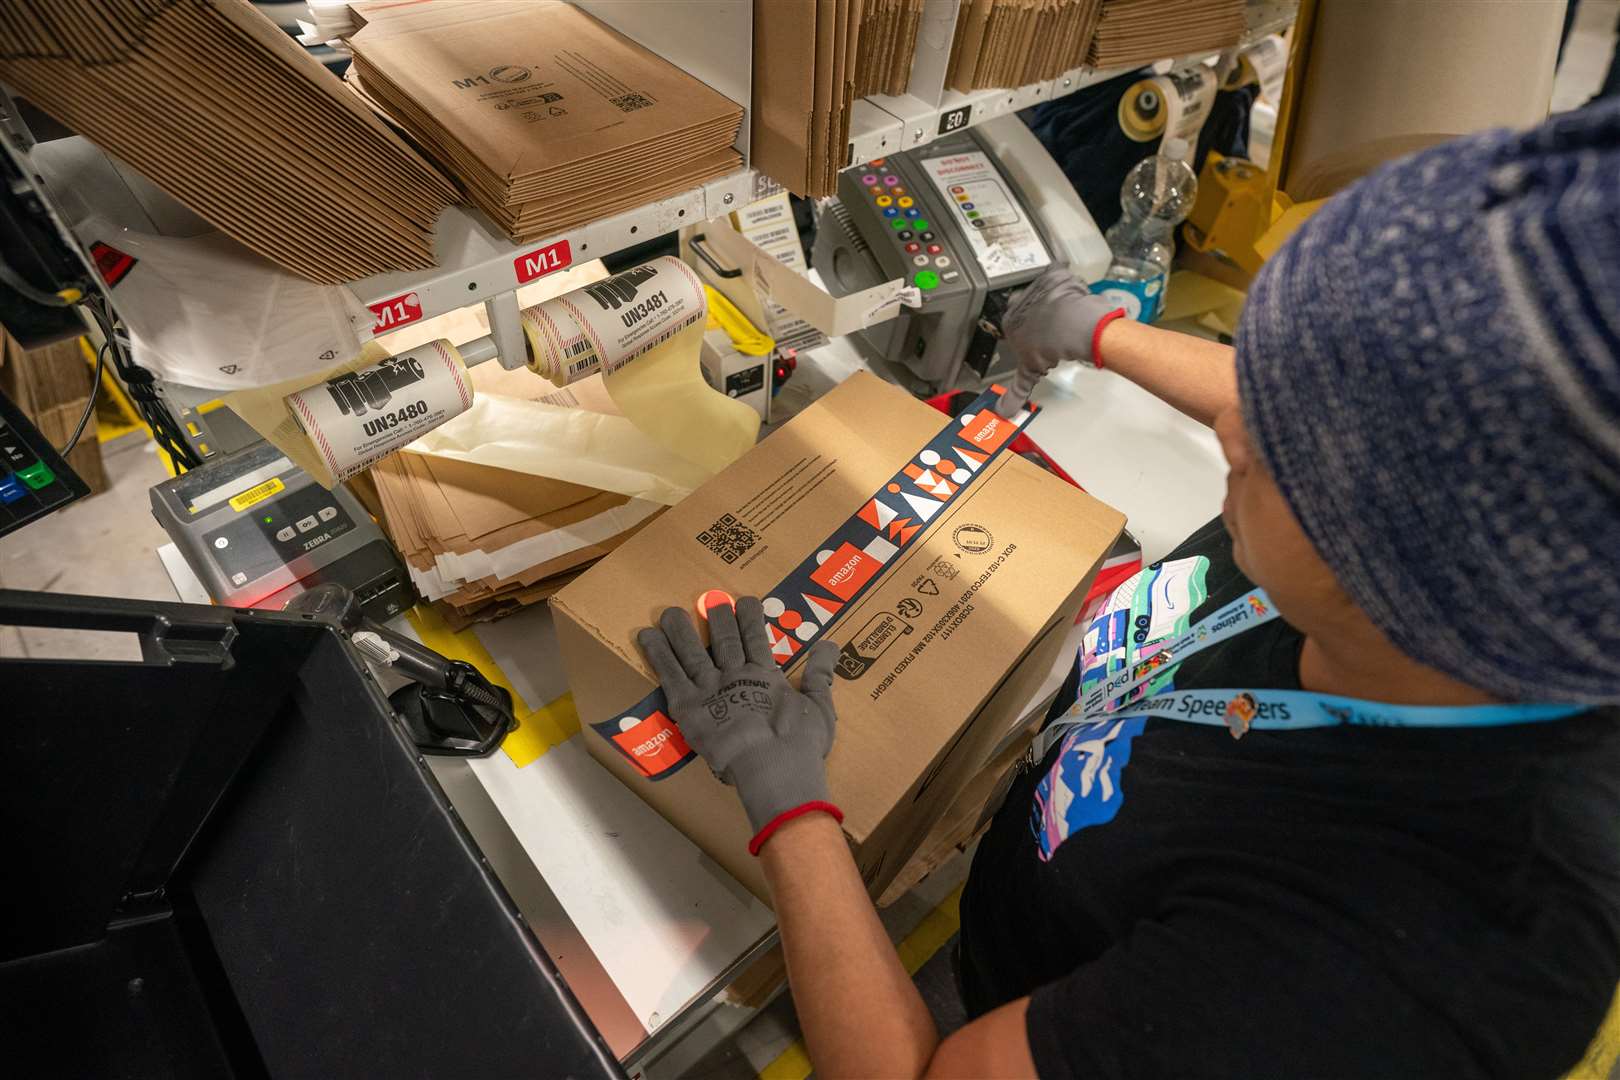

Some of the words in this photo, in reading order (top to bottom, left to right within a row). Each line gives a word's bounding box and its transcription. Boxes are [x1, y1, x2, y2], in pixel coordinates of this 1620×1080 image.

[451, 74, 491, 90] M1
[525, 248, 562, 277] M1
[374, 300, 410, 329] M1
[621, 290, 668, 328] UN3481
[363, 400, 428, 437] UN3480
[974, 418, 1000, 442] amazon
[303, 532, 332, 551] ZEBRA
[1002, 543, 1017, 559] BOX
[828, 554, 863, 587] amazon
[987, 555, 1006, 573] C-102
[970, 570, 992, 592] FEFCO
[940, 604, 975, 641] DCBOX1117
[1211, 610, 1248, 634] Latinos
[911, 641, 927, 655] MM
[894, 652, 916, 674] FIXED
[870, 672, 897, 701] HEIGHT
[631, 727, 674, 757] amazon
